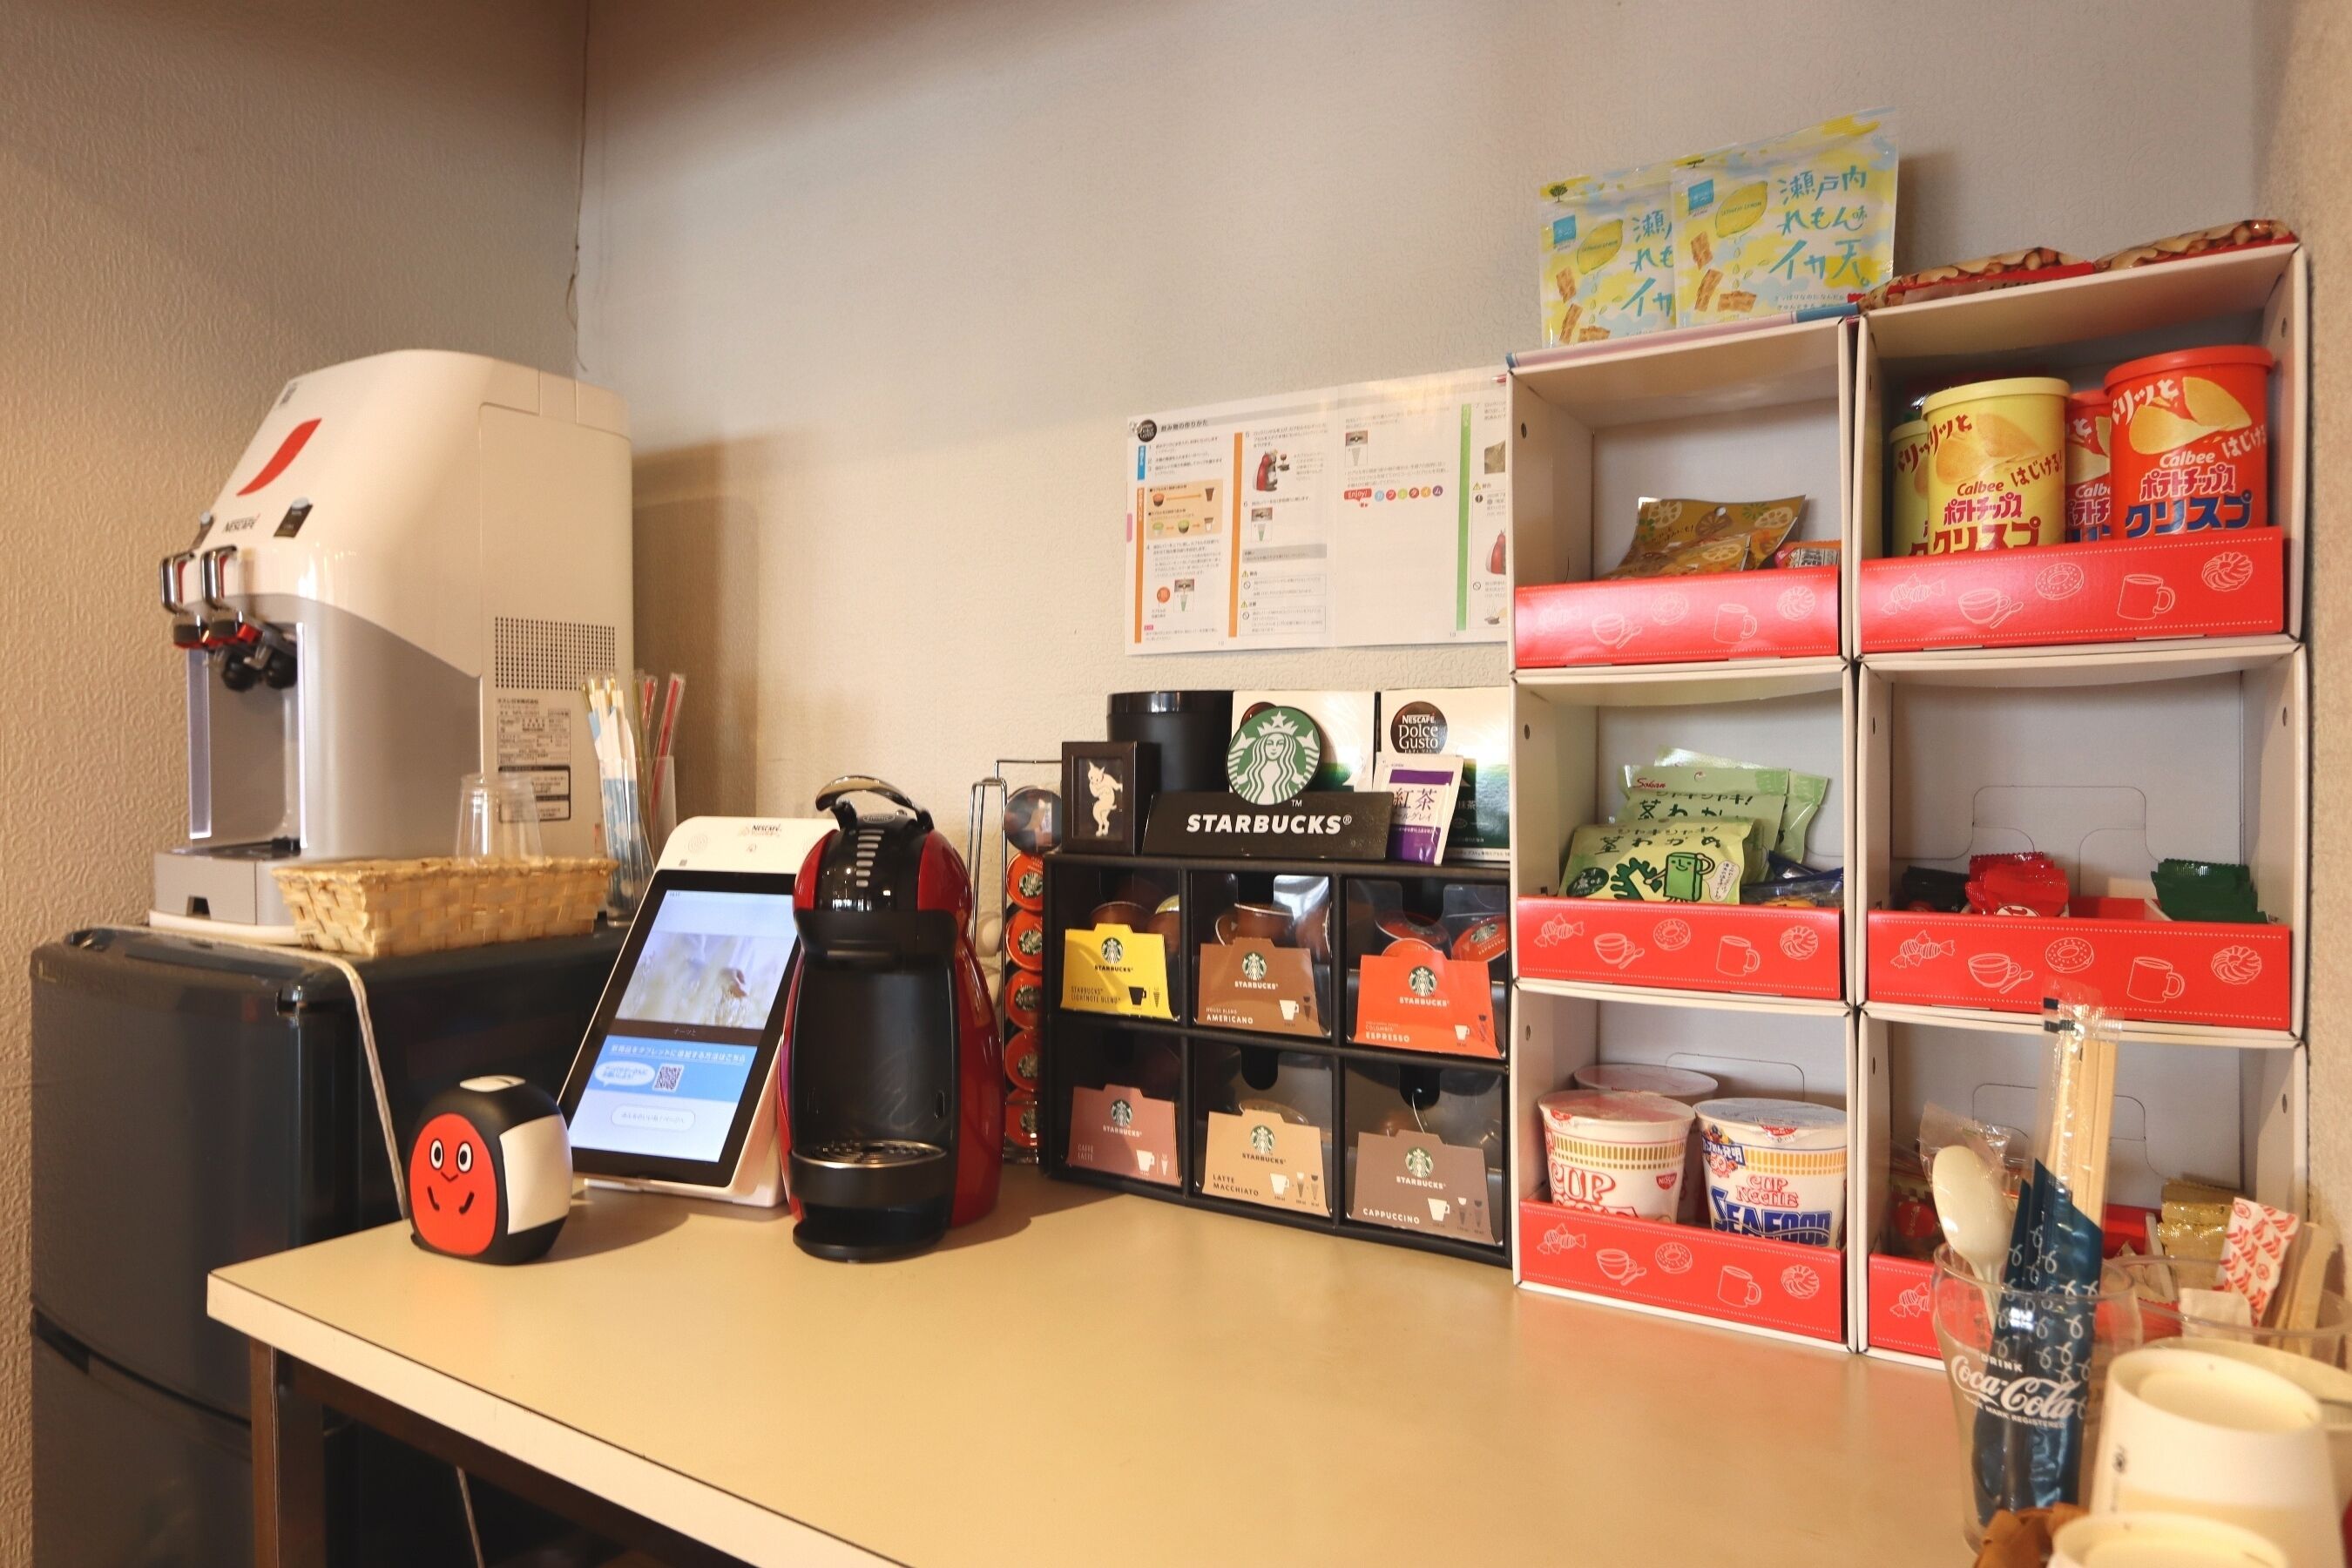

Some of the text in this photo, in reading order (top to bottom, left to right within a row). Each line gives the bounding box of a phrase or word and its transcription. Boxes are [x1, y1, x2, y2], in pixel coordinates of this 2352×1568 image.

[1778, 165, 1867, 205] 瀬戸内
[1777, 205, 1868, 237] れもん味
[1927, 414, 1972, 456] リッと
[2011, 449, 2063, 488] はじける!
[2159, 449, 2215, 469] Calbee
[1957, 480, 2004, 497] Calbee
[2139, 462, 2235, 503] ポテトチップス
[1347, 490, 1369, 500] Enjoy!
[1943, 491, 2022, 526] ポテトチップス
[2125, 490, 2253, 538] クリスプ
[1933, 516, 2042, 555] クリスプ
[1398, 724, 1438, 739] Dolce
[1398, 737, 1438, 750] Gusto
[1393, 787, 1437, 811] 紅茶
[1206, 1013, 1254, 1025] AMERICANO
[1365, 1031, 1410, 1044] ESPRESSO
[1213, 1173, 1235, 1185] LATTE
[1550, 1159, 1616, 1205] CUP
[1746, 1173, 1788, 1193] CUP
[1213, 1182, 1260, 1197] MACCHIATO
[1362, 1207, 1421, 1225] CAPPUCCINO
[1710, 1185, 1833, 1247] SEAFOOD
[1980, 1353, 2024, 1373] DRINK
[1950, 1355, 2080, 1420] Coca-Cola
[2011, 1413, 2067, 1429] REGISTERED
